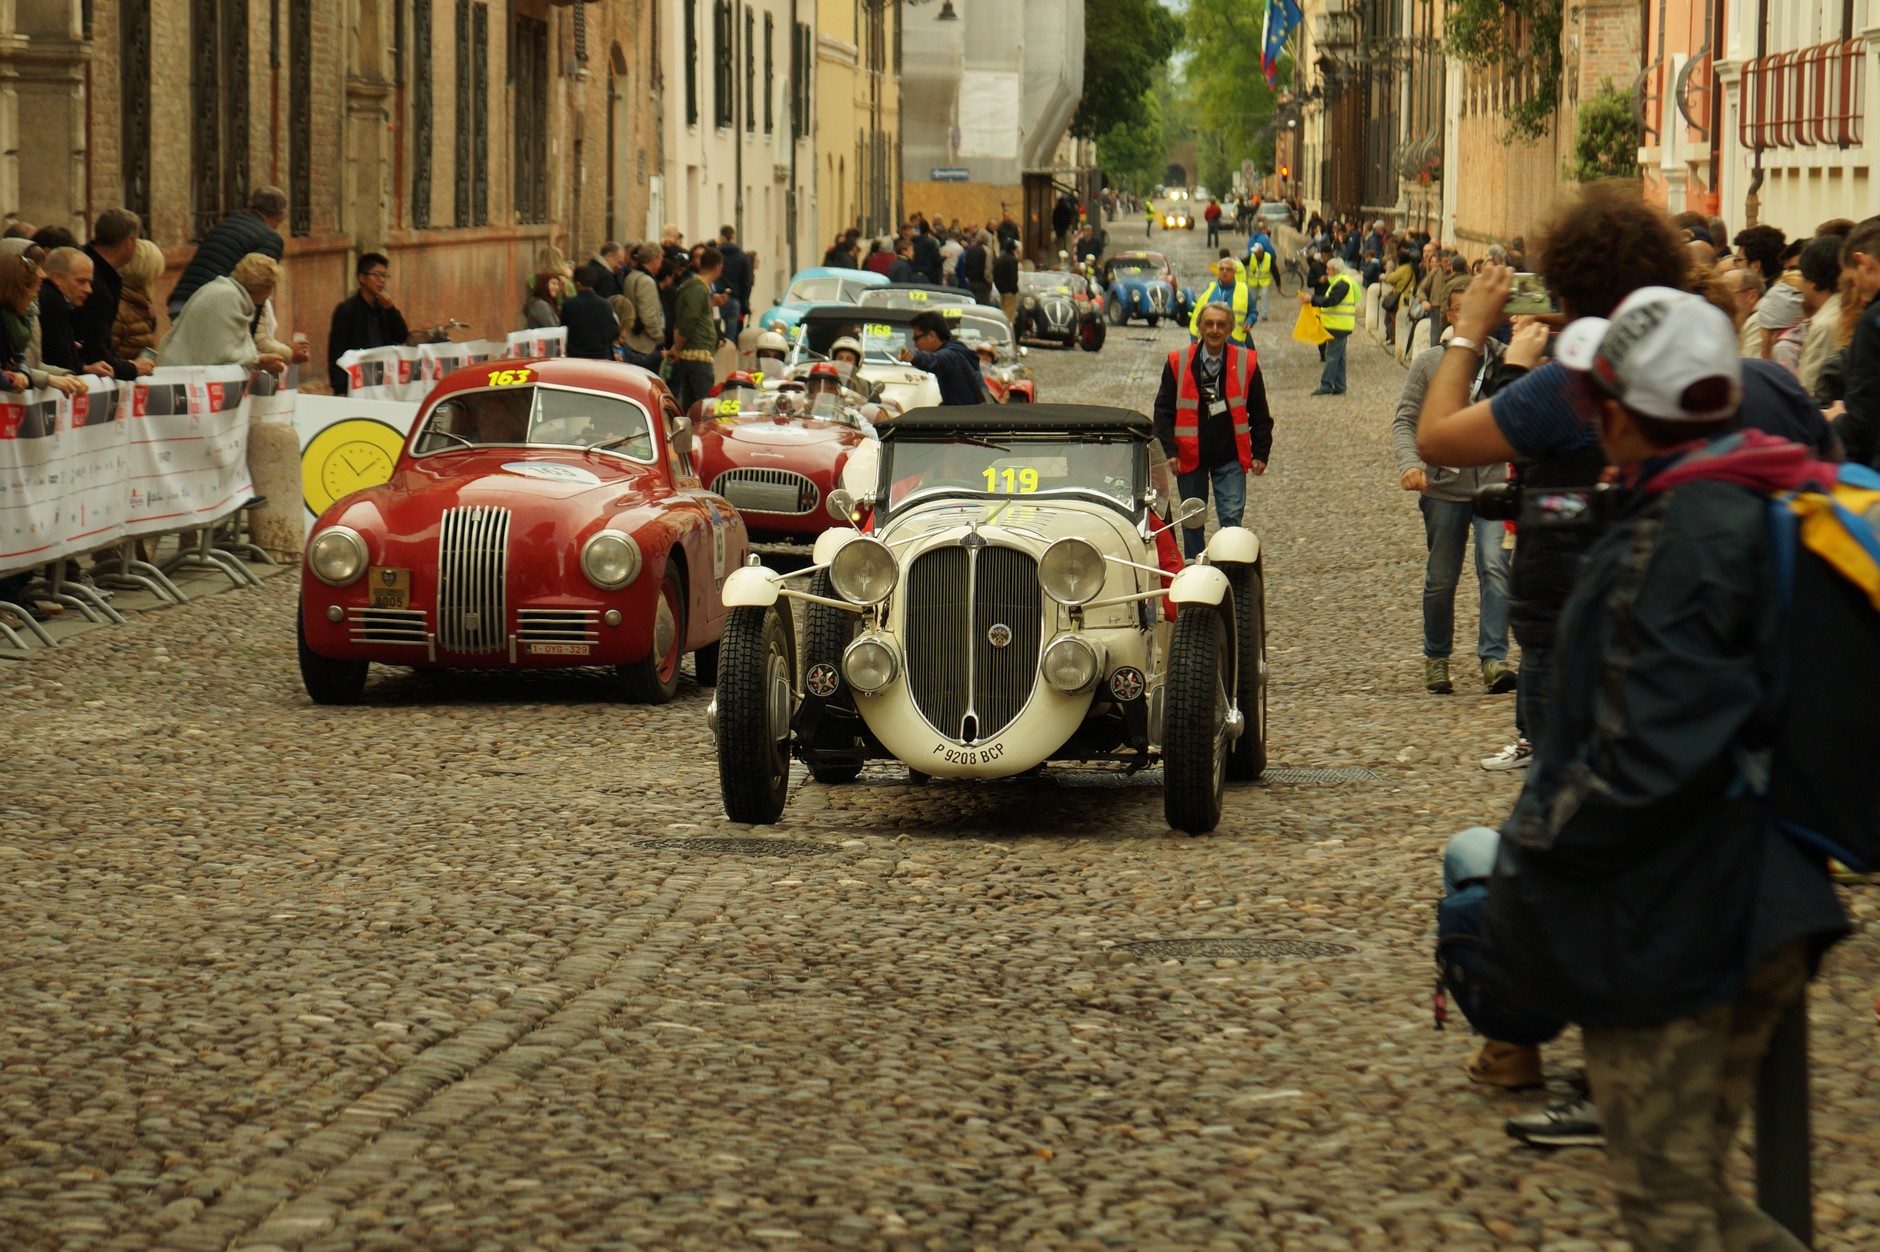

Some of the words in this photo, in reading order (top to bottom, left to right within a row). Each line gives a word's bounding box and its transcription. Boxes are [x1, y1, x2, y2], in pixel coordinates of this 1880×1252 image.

[867, 323, 892, 337] 168
[488, 369, 531, 387] 163
[714, 399, 741, 415] 165
[982, 467, 1039, 493] 119
[932, 743, 945, 754] P
[944, 749, 977, 765] 9208
[980, 743, 1004, 764] BCP
